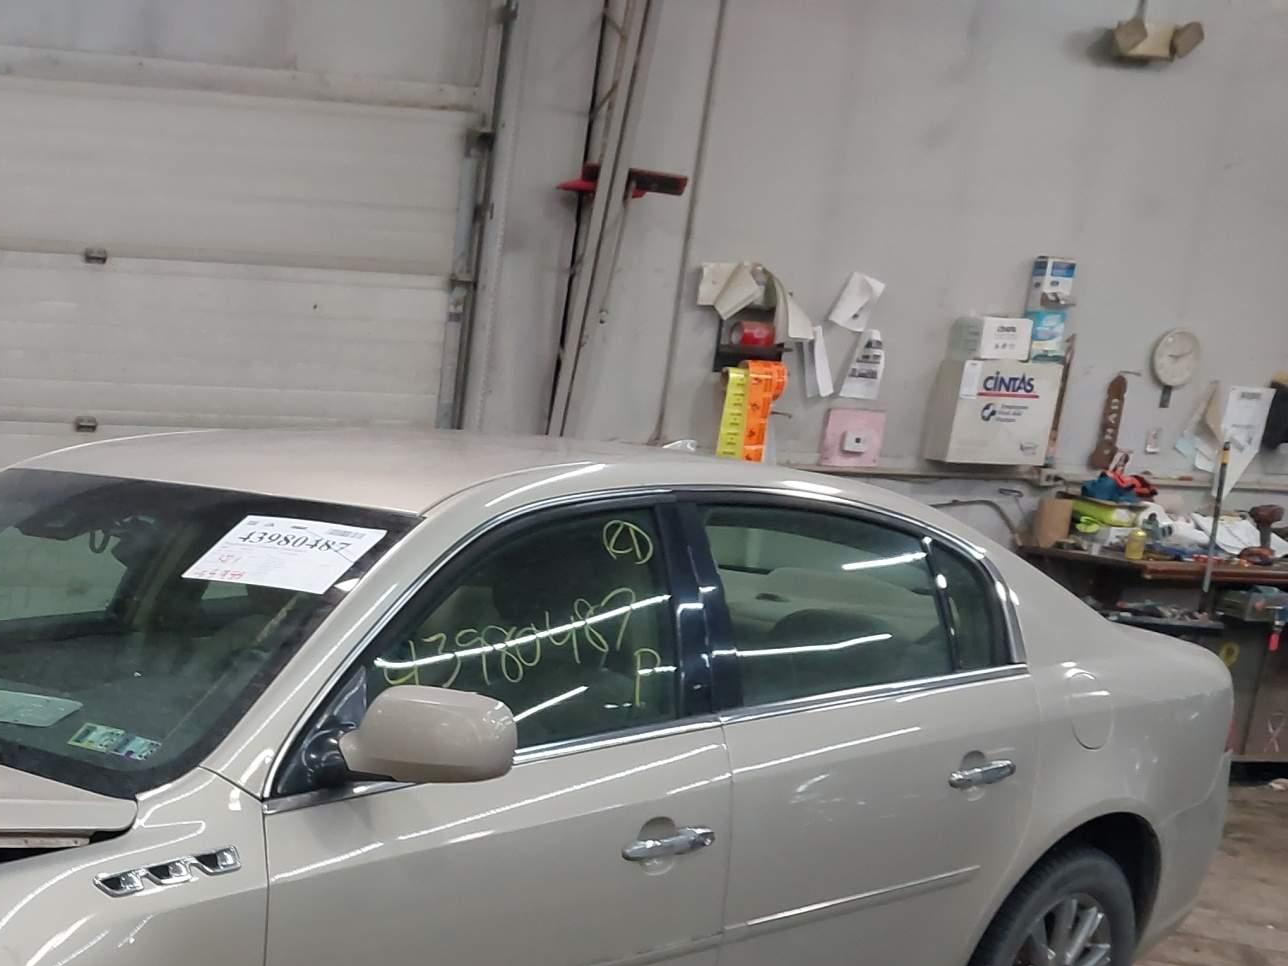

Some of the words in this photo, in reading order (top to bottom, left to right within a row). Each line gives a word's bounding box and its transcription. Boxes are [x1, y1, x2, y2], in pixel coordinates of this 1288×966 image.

[983, 371, 1035, 393] CINTAS
[238, 529, 353, 553] 43980487
[383, 587, 636, 688] 43980487
